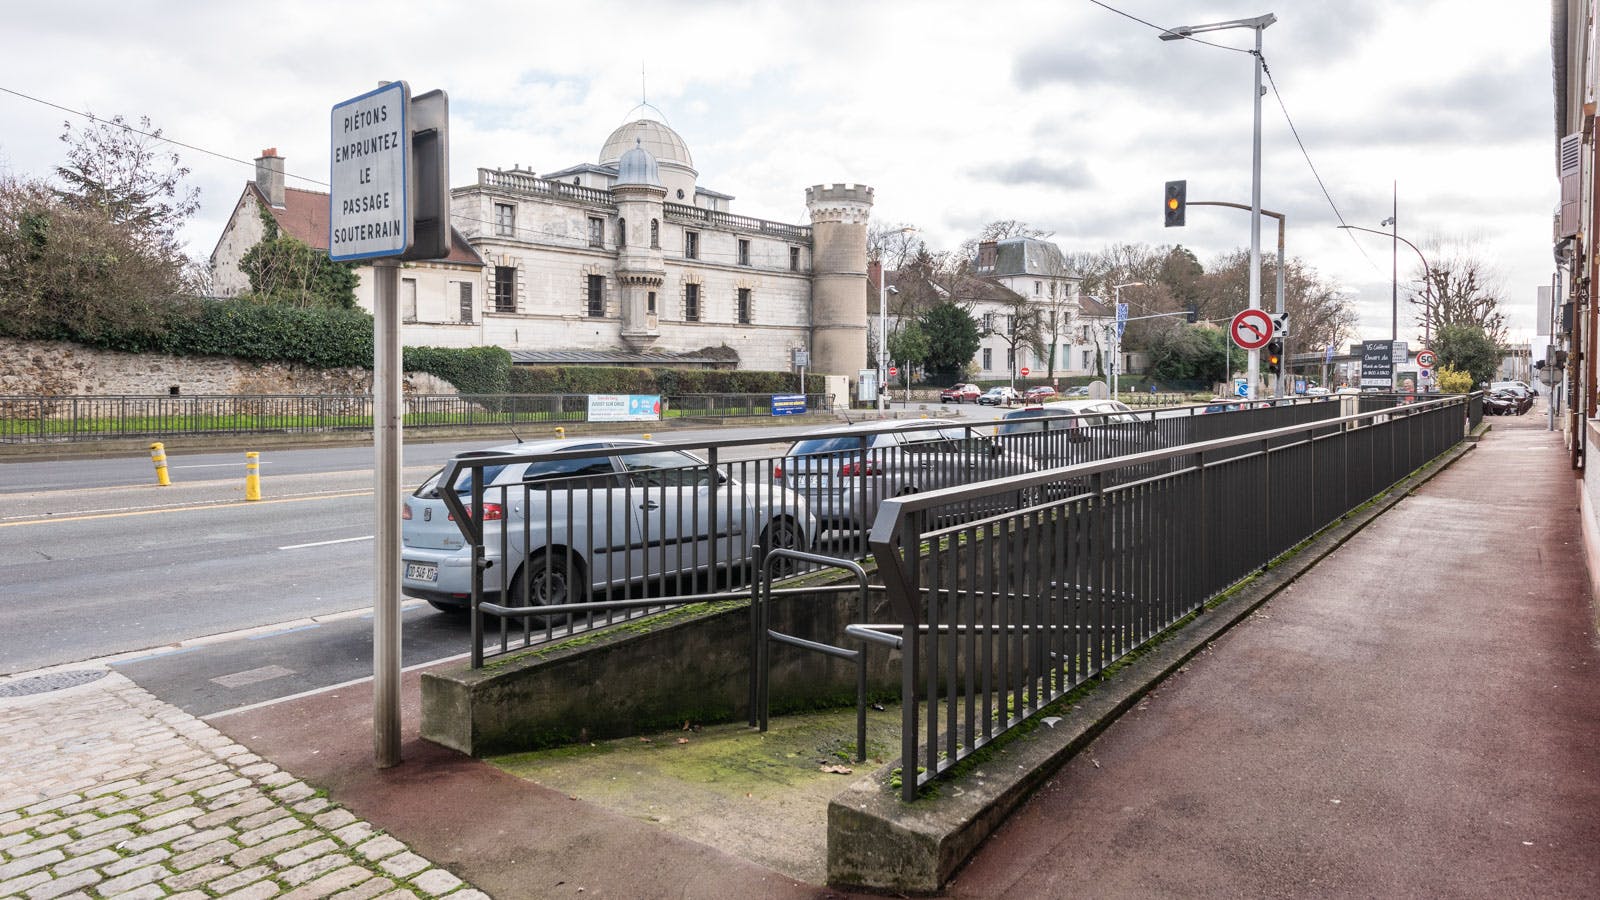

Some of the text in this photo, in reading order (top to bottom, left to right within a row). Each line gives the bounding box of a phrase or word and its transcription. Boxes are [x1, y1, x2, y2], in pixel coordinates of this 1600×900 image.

[344, 105, 387, 133] PIÉTONS
[335, 131, 398, 163] EMPRUNTEZ
[359, 167, 371, 185] LE
[343, 192, 390, 216] PASSAGE
[334, 219, 400, 244] SOUTERRAIN
[1421, 355, 1433, 363] 50
